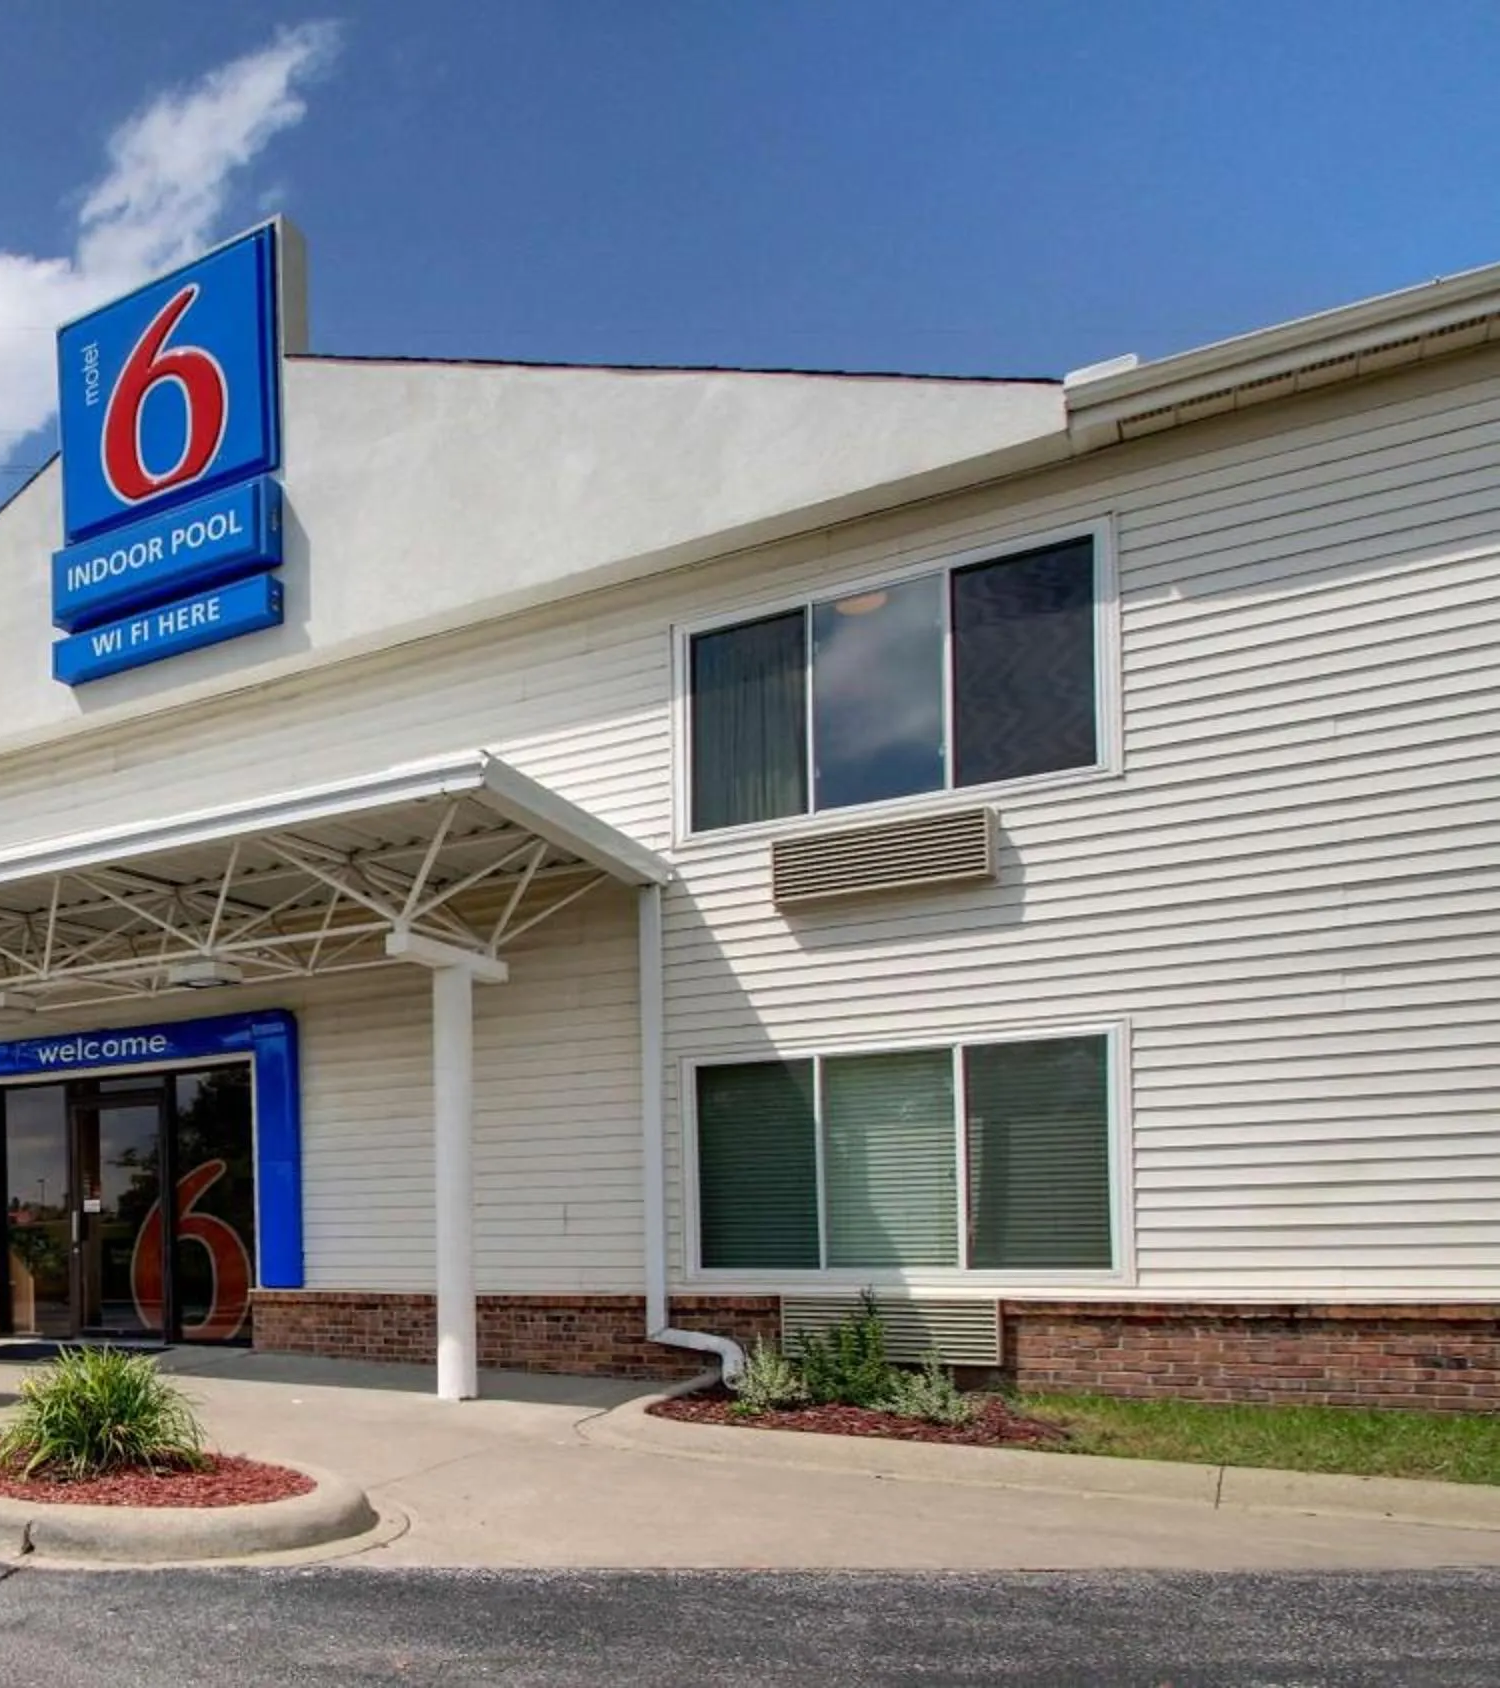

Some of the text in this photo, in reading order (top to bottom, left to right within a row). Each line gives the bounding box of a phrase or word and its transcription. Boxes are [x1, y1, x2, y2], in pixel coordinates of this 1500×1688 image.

[85, 341, 98, 406] motel
[101, 283, 228, 505] 6
[67, 510, 243, 592] INDOOR POOL
[91, 597, 221, 657] WI FI HERE
[37, 1033, 168, 1065] welcome
[131, 1159, 251, 1339] 6
